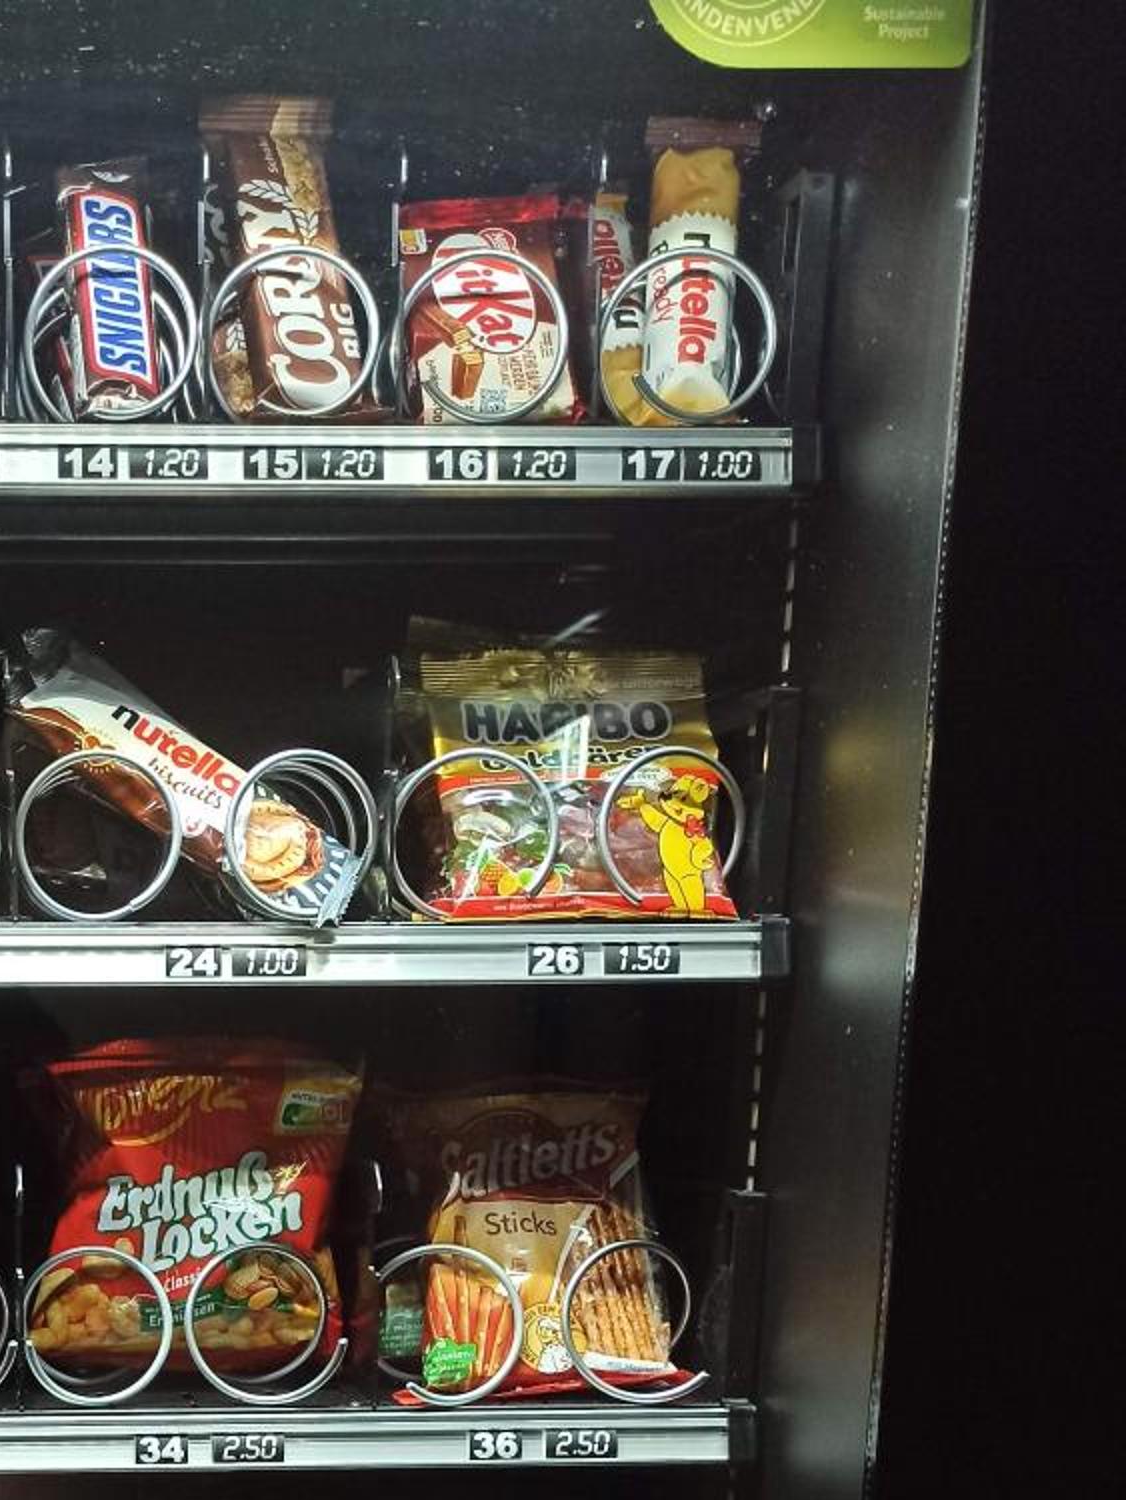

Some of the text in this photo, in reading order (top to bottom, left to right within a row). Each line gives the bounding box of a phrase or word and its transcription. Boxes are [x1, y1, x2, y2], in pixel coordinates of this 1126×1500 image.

[862, 6, 946, 22] Sustainable
[877, 23, 930, 43] Project
[63, 450, 200, 479] 14 1.20
[248, 450, 377, 479] 15 1.20
[434, 450, 568, 479] 16 1.20
[626, 450, 753, 479] 17 1.00
[112, 704, 244, 798] nutella
[148, 756, 223, 810] biscuits
[169, 946, 300, 977] 24 1.00
[531, 943, 671, 975] 26 1.50
[97, 1151, 274, 1233] Erdnuß
[141, 1191, 303, 1275] Locken
[485, 1211, 558, 1237] Sticks
[138, 1434, 277, 1464] 34 2.50
[473, 1430, 611, 1459] 36 2.50
